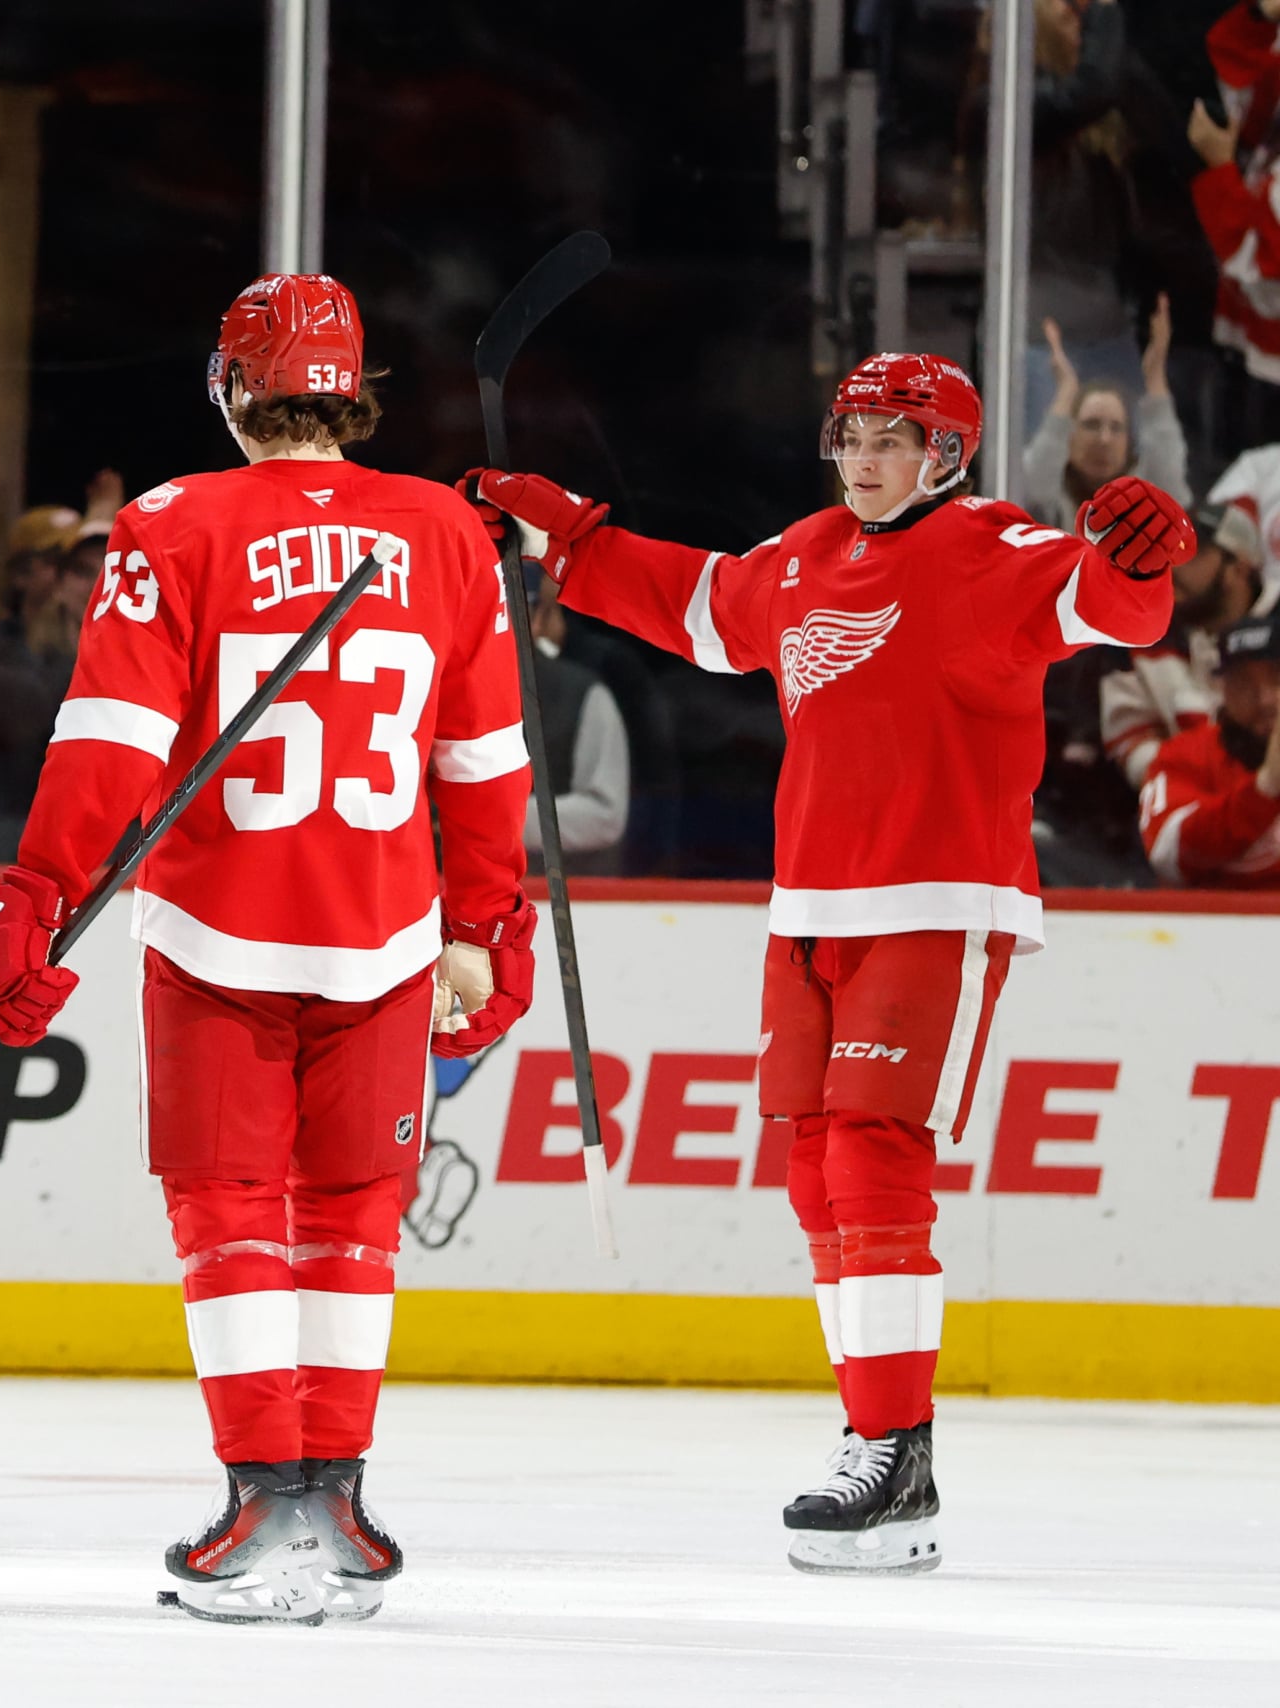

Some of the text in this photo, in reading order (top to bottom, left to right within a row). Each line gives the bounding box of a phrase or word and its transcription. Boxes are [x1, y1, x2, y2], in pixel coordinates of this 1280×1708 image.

[307, 364, 336, 390] 53
[847, 383, 883, 396] CCM
[246, 524, 410, 613] SEIDER
[92, 550, 160, 624] 53
[219, 627, 436, 833] 53
[831, 1041, 908, 1063] CCM
[496, 1049, 1120, 1196] BEE
[195, 1535, 234, 1569] BAUER
[353, 1534, 386, 1563] BAUER
